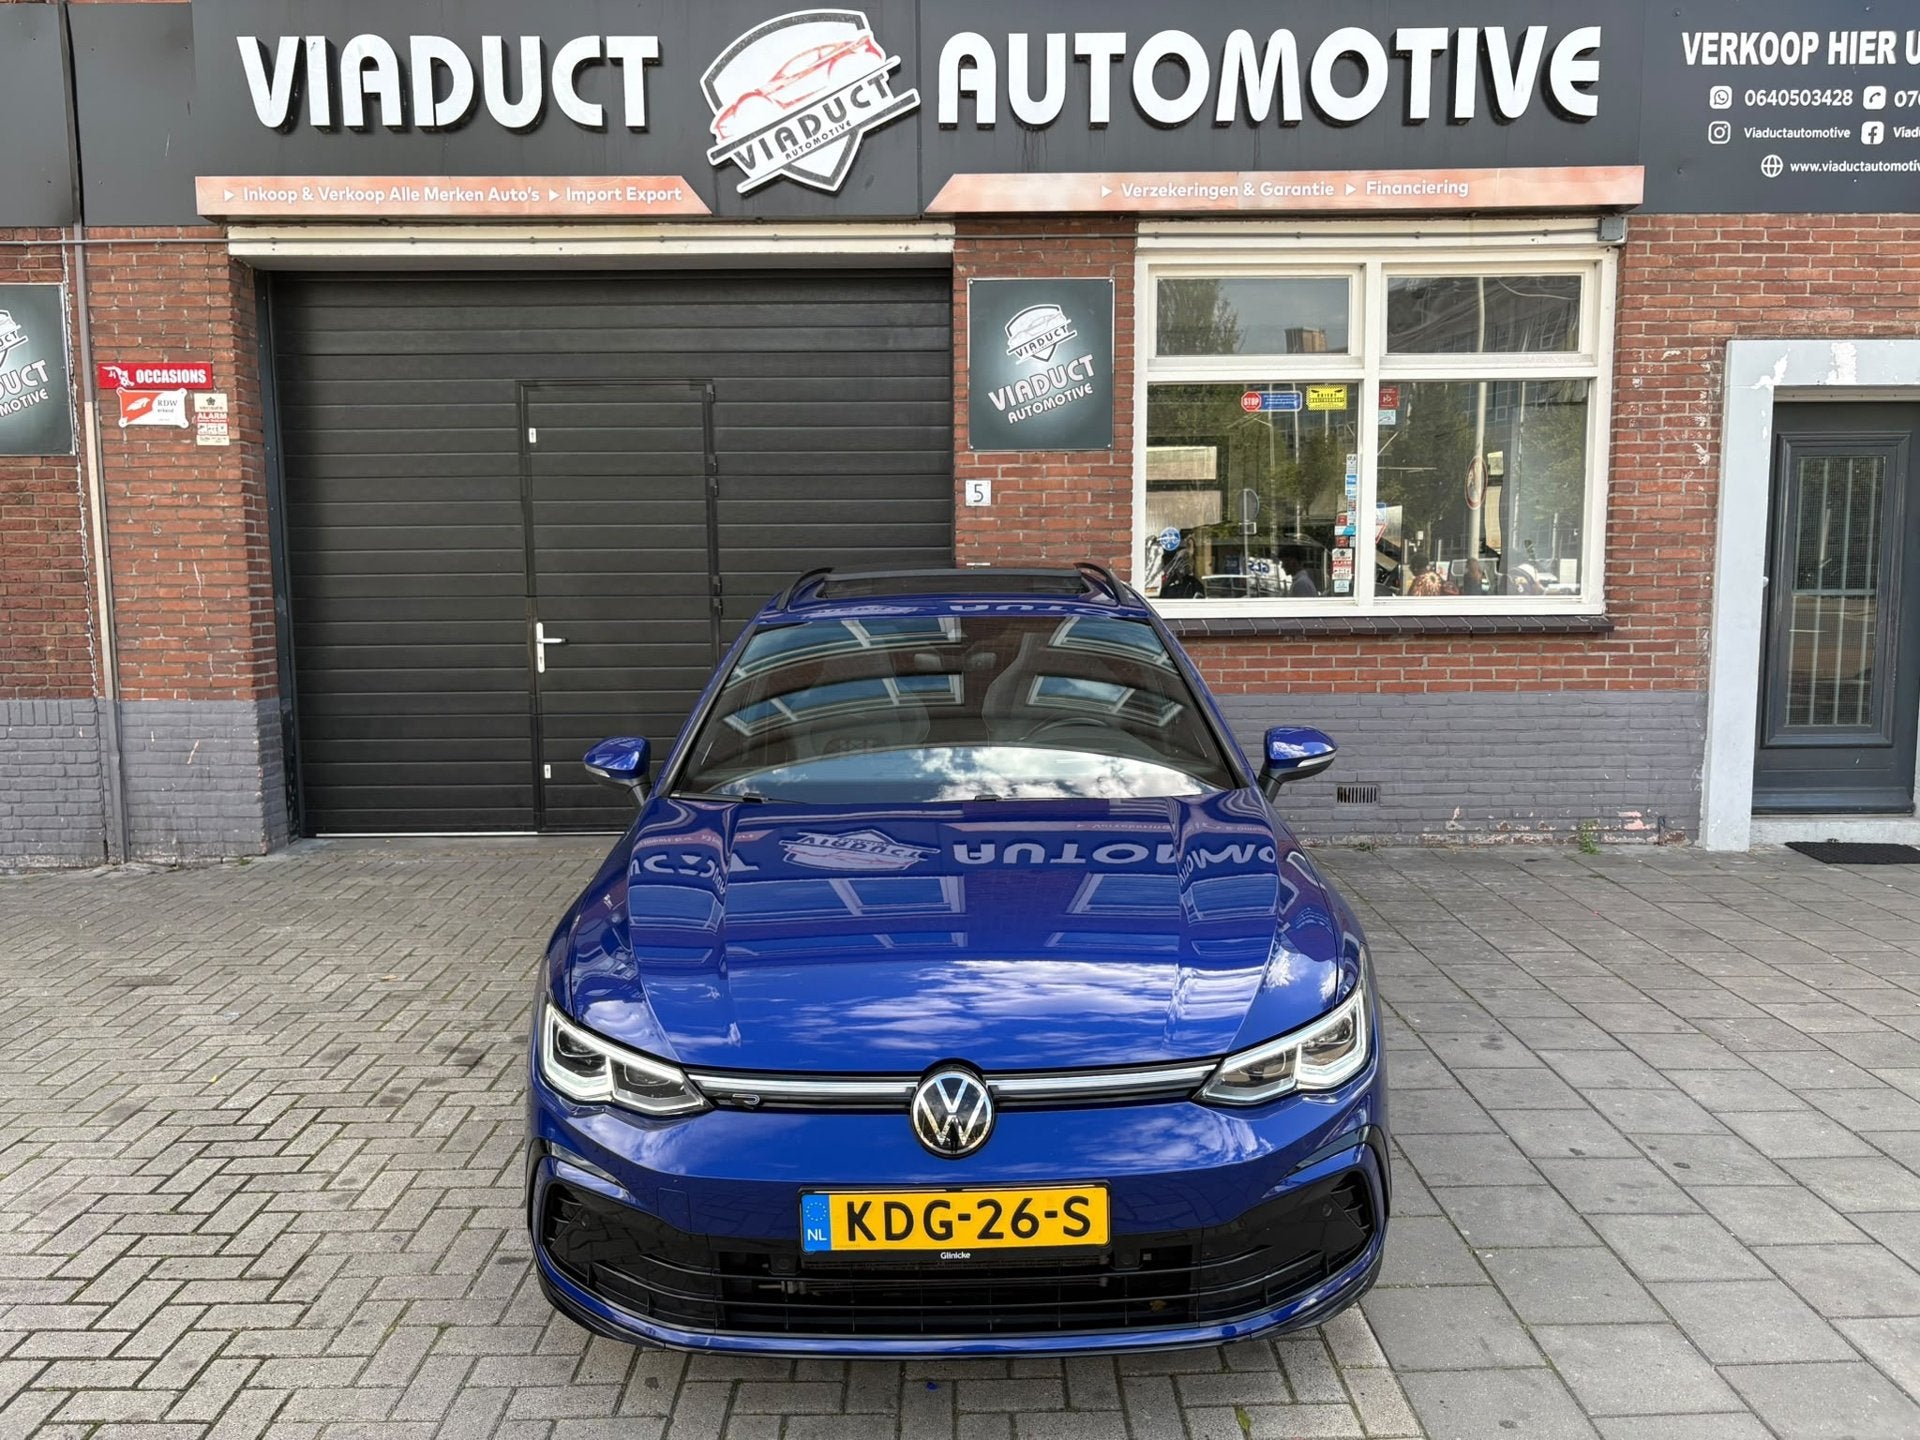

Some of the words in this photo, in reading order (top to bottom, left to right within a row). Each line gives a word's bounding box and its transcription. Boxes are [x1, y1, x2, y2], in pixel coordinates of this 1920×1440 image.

[1681, 31, 1819, 66] VERKOOP
[1827, 30, 1897, 66] HIER
[236, 33, 660, 131] VIADUCT
[937, 25, 1602, 126] AUTOMOTIVE
[1744, 89, 1853, 107] 0640503428
[1894, 90, 1920, 107] 07
[733, 72, 890, 171] VIADUCT
[784, 119, 853, 160] AUTOMOTIVE
[1743, 126, 1851, 139] Viaductautomotive
[243, 186, 298, 205] Inkoop
[301, 187, 314, 202] &
[317, 186, 385, 205] Verkoop
[389, 186, 420, 202] Alle
[423, 186, 483, 202] Merken
[488, 186, 540, 202] Auto's
[566, 186, 622, 205] Import
[626, 187, 682, 205] Export
[1121, 182, 1239, 202] Verzekeringen
[1243, 182, 1256, 196] &
[1260, 181, 1335, 198] Garantie
[1366, 179, 1469, 199] Financiering
[1016, 325, 1069, 358] VIADUCT
[0, 359, 49, 399] UCT
[135, 368, 207, 384] OCCASIONS
[987, 353, 1096, 412] VIADUCT
[157, 399, 178, 407] RDW
[1007, 382, 1094, 424] AUTOMOTIVE
[1243, 397, 1260, 407] STOP
[197, 412, 228, 420] ALARM
[973, 483, 985, 503] 5
[846, 1195, 1092, 1243] KDG-26-S
[807, 1229, 827, 1242] NL
[940, 1251, 971, 1260] Glinicke
